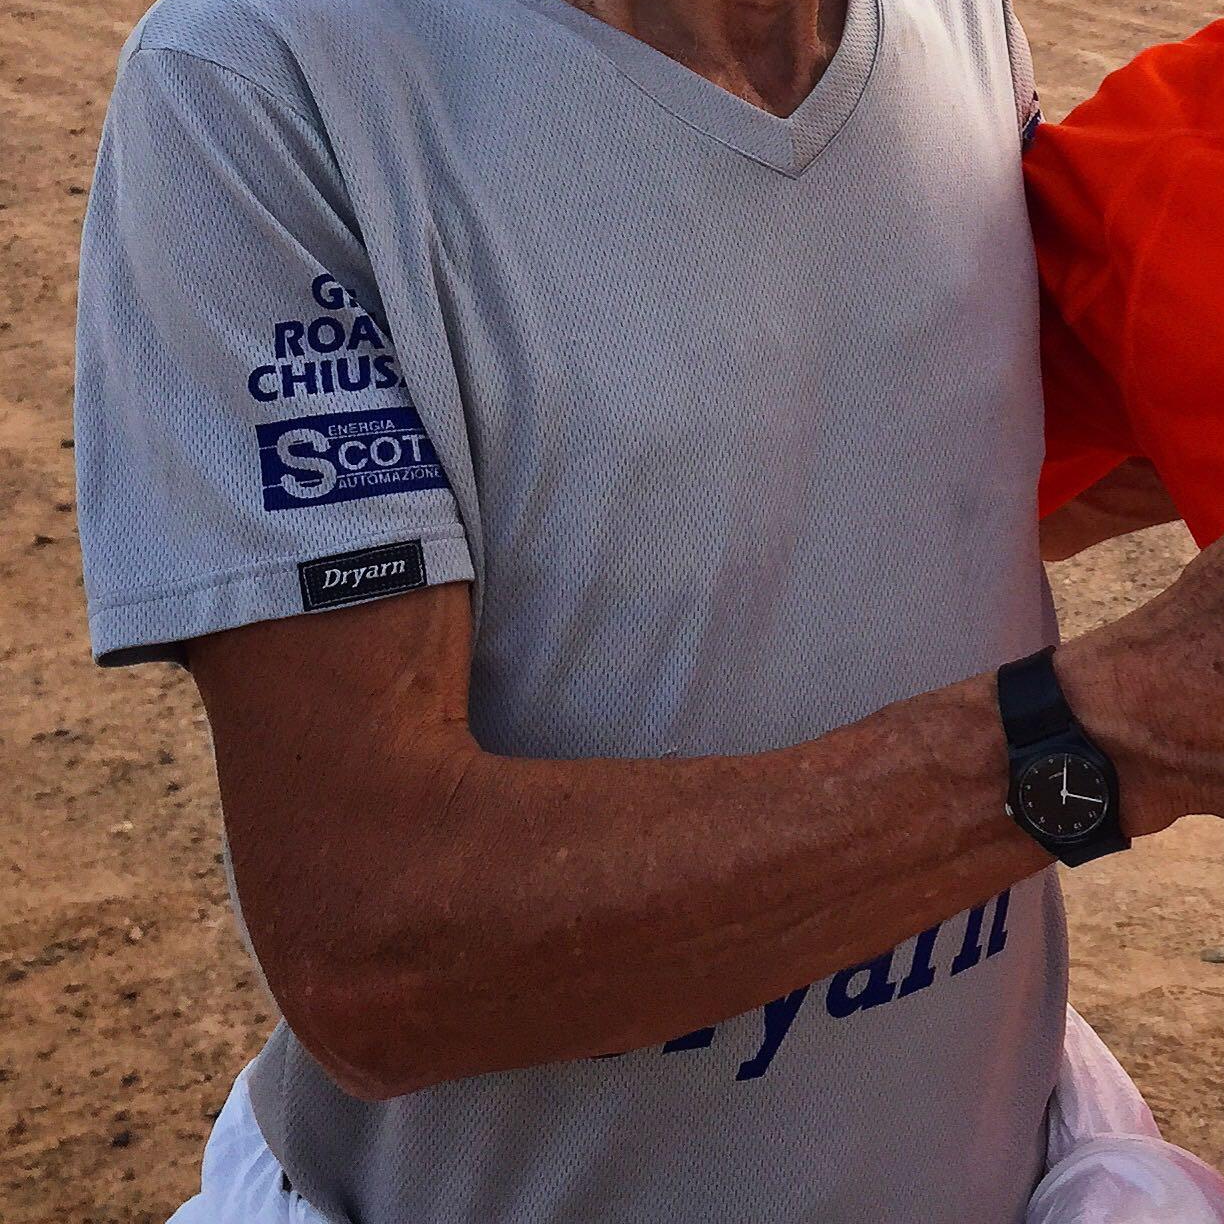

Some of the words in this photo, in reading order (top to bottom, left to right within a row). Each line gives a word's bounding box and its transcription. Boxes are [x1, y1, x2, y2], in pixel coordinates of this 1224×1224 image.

[248, 354, 407, 403] CHIUS
[328, 419, 396, 436] ENERGIA
[322, 560, 406, 589] Dryarn
